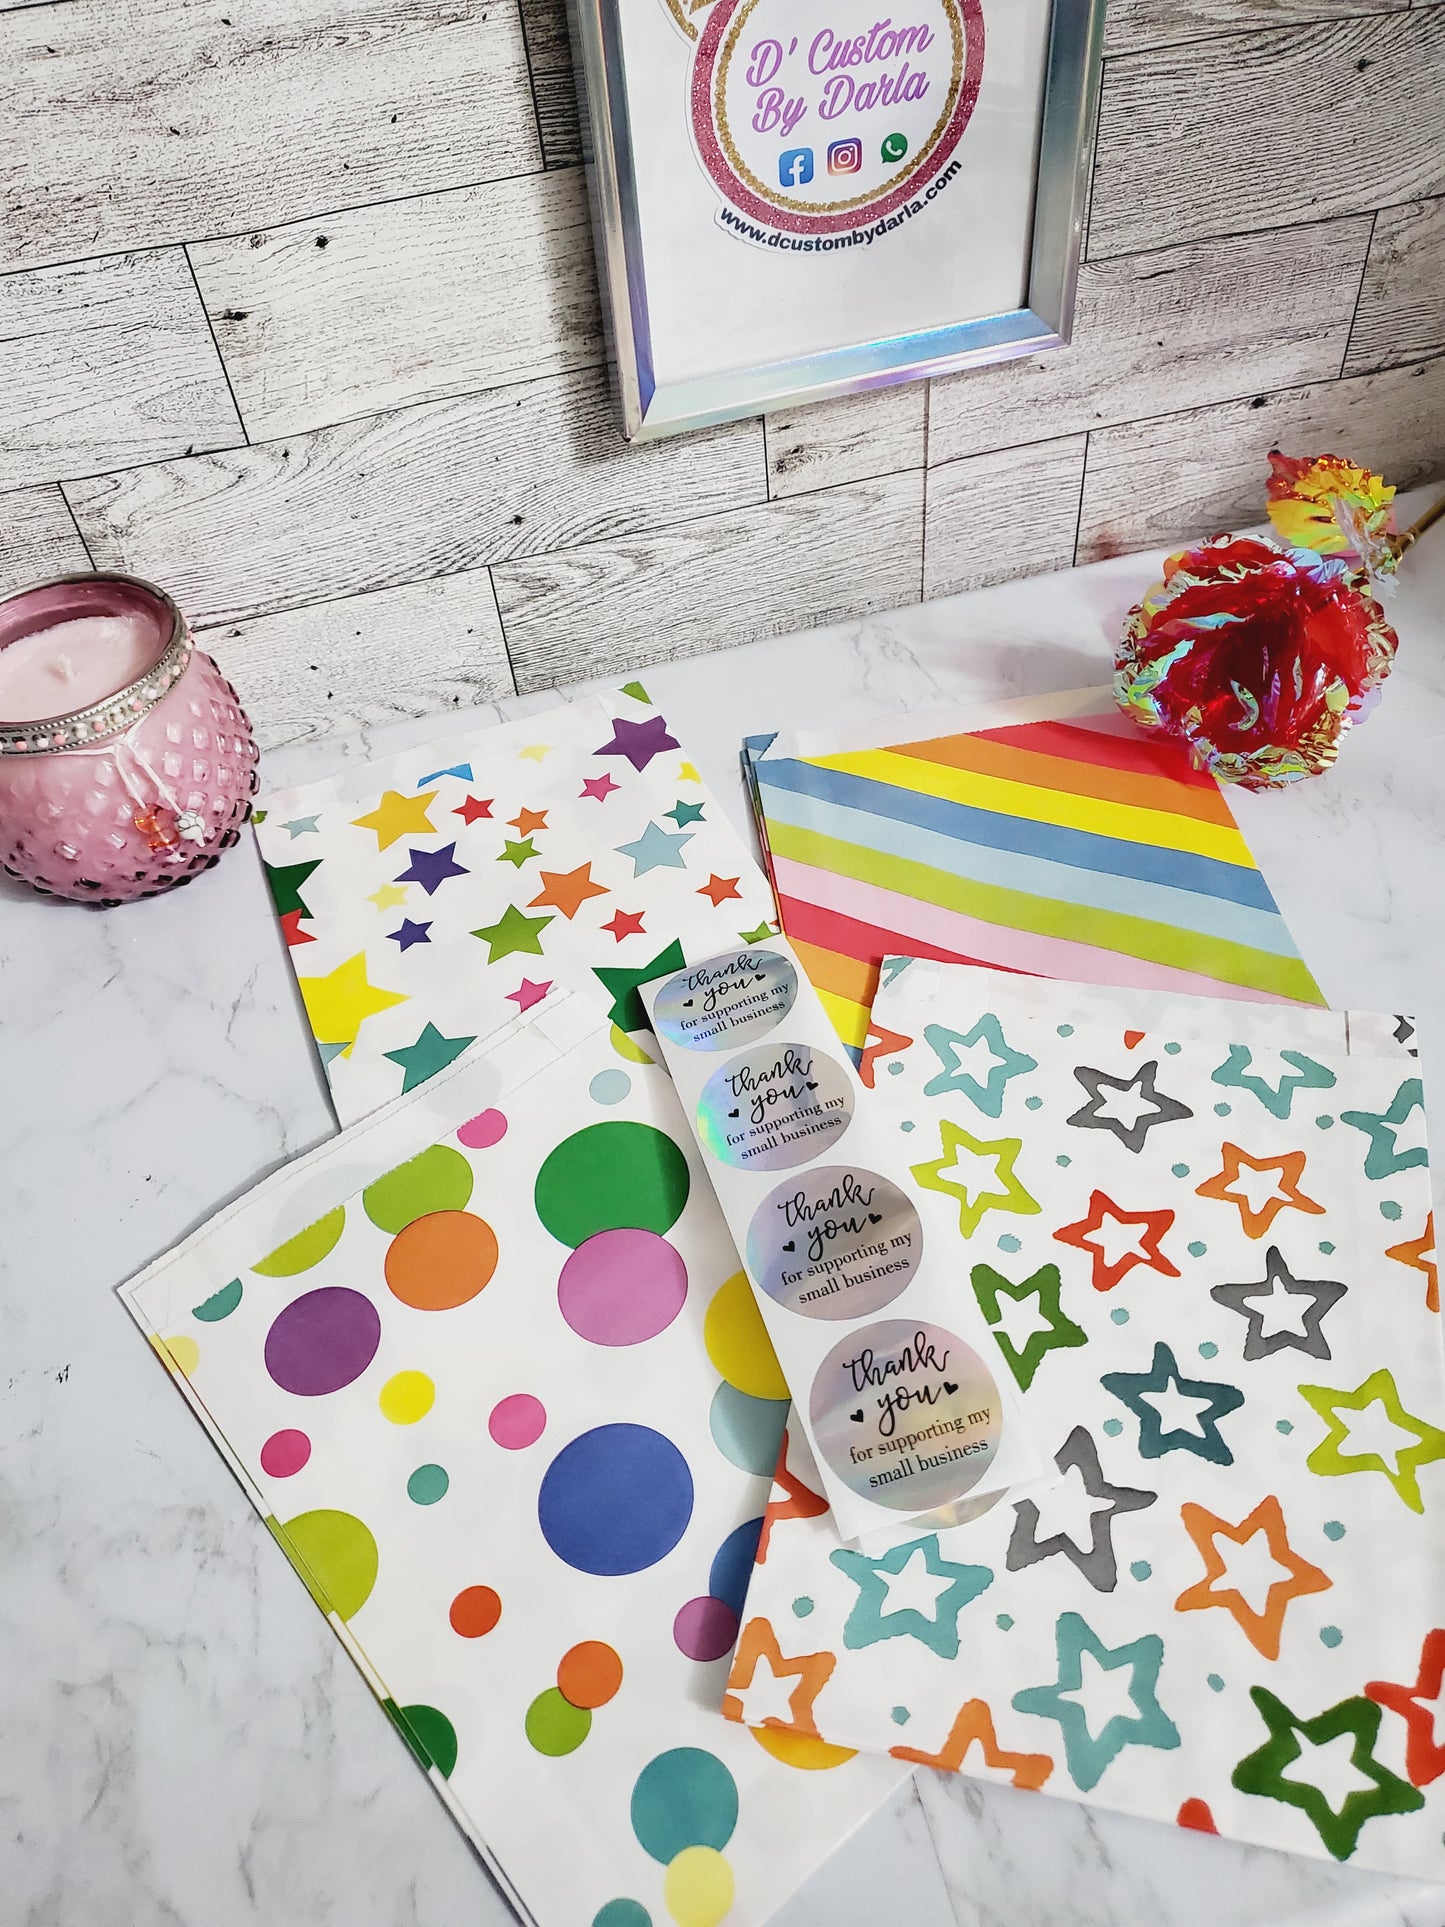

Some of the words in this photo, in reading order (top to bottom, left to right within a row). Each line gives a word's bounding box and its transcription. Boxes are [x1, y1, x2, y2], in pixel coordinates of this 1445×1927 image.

[808, 19, 935, 75] Custom
[752, 86, 808, 137] By
[818, 62, 930, 120] Darla
[719, 160, 962, 251] www.dcustombydarla.com
[682, 954, 763, 991] thank
[703, 976, 753, 1012] you
[680, 1019, 698, 1031] for
[701, 991, 769, 1023] supporting
[771, 983, 789, 1000] my
[693, 1019, 728, 1042] small
[731, 1002, 786, 1027] business
[725, 1049, 813, 1097] thank
[726, 1133, 746, 1147] for
[749, 1103, 823, 1138] supporting
[824, 1096, 845, 1115] my
[750, 1083, 806, 1125] you
[741, 1136, 778, 1160] small
[783, 1116, 842, 1143] business
[777, 1174, 875, 1227] thank
[780, 1270, 803, 1286] for
[807, 1240, 888, 1279] supporting
[890, 1231, 913, 1250] my
[807, 1213, 867, 1262] you
[798, 1278, 841, 1305] small
[845, 1257, 911, 1289] business
[842, 1330, 950, 1392] thank
[849, 1446, 874, 1464] for
[877, 1417, 965, 1456] supporting
[967, 1406, 992, 1427] my
[876, 1385, 943, 1437] you
[869, 1459, 915, 1489] small
[920, 1437, 990, 1473] business
